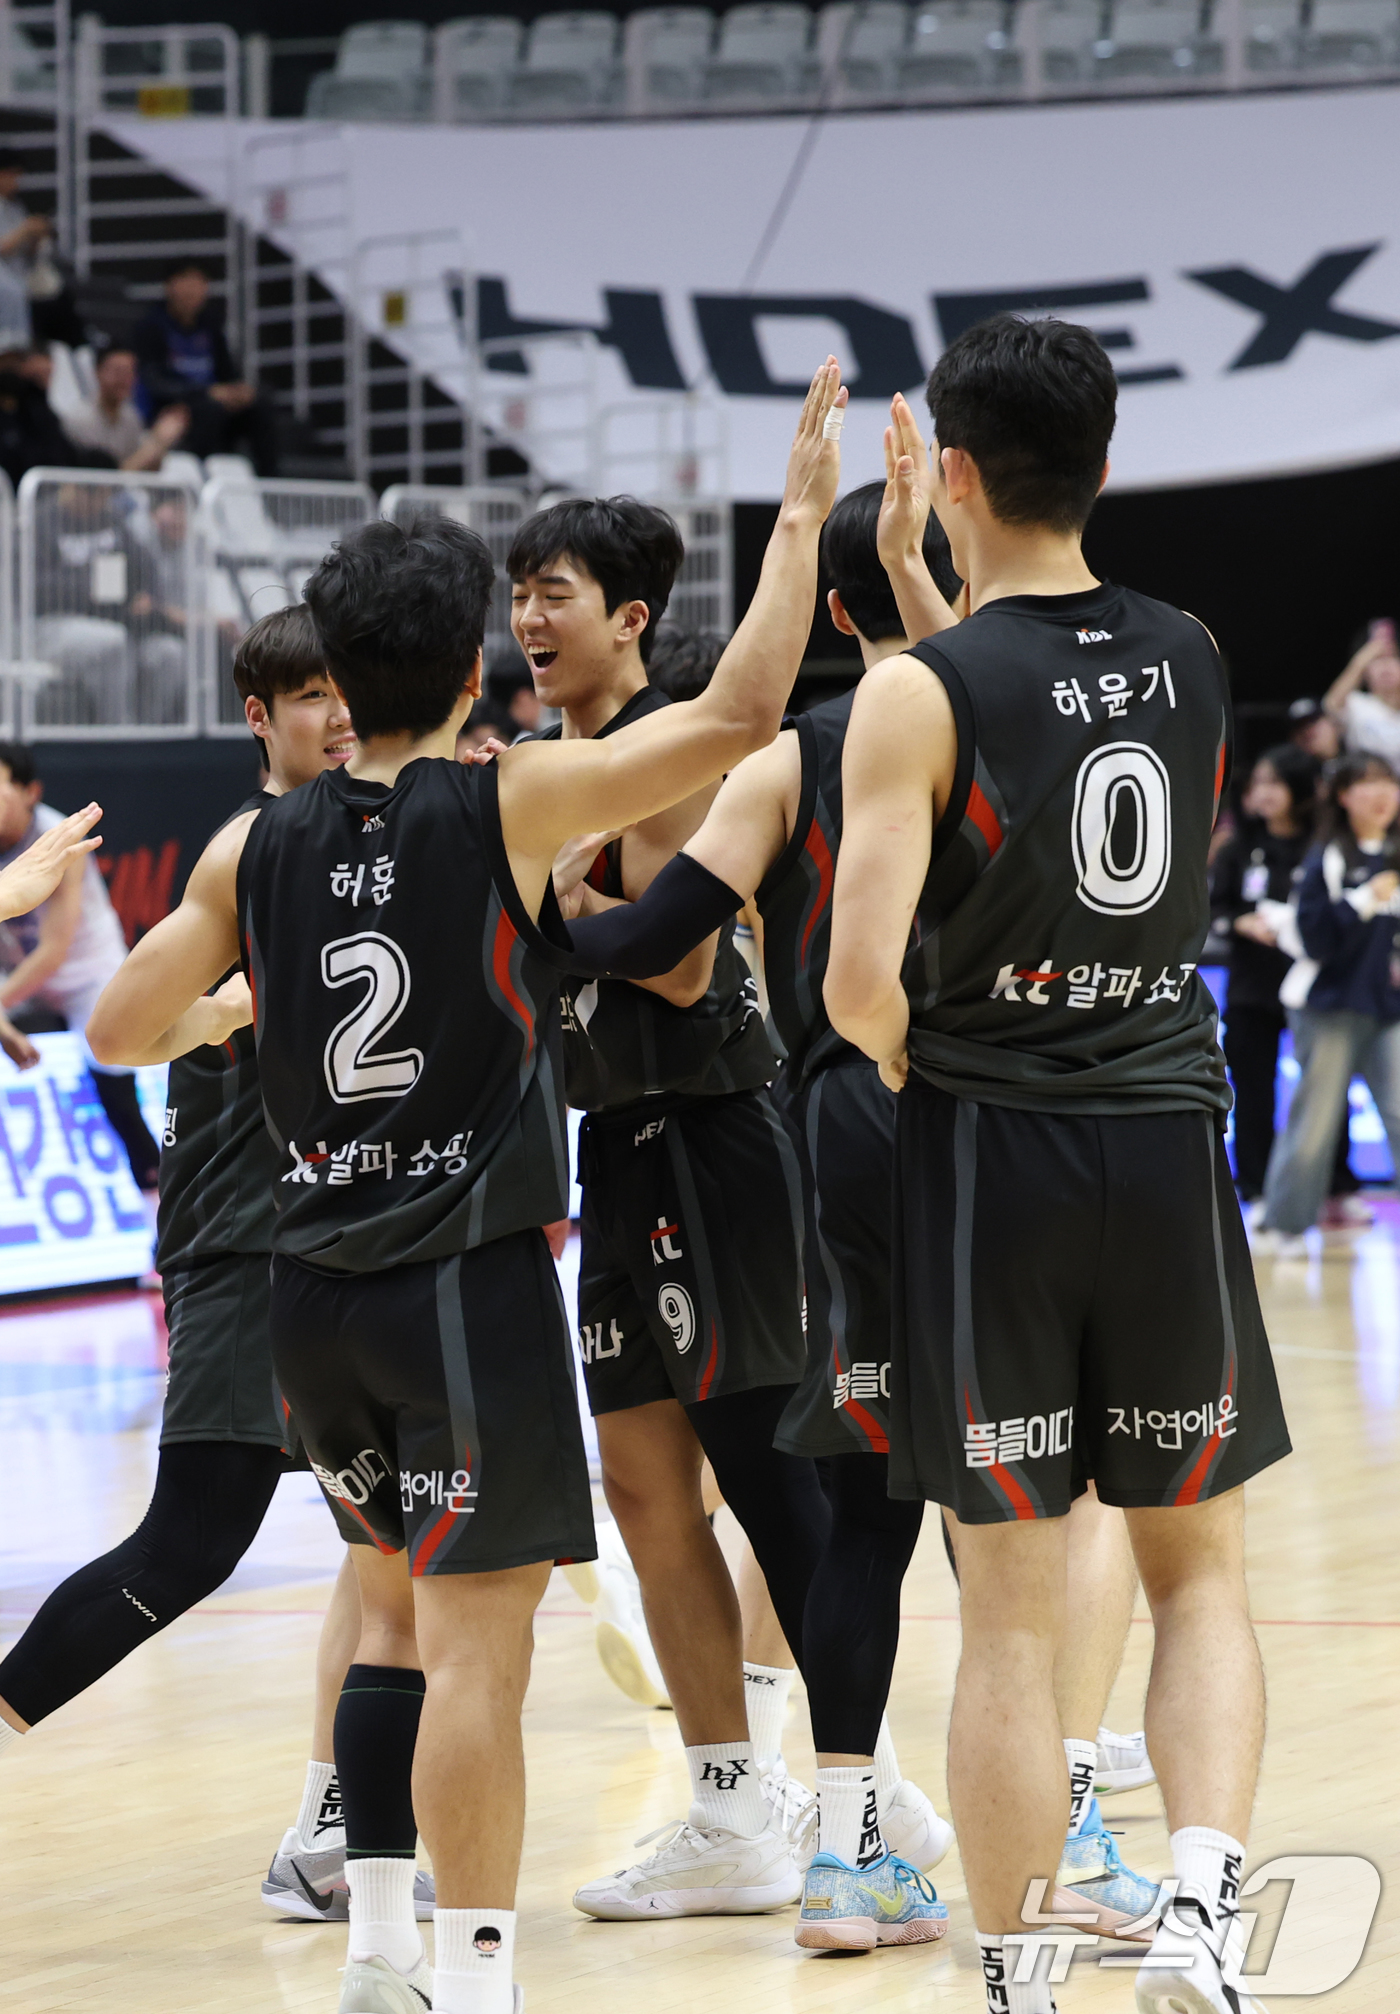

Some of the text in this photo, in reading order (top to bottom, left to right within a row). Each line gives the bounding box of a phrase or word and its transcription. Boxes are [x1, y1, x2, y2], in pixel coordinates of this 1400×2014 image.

[446, 239, 1400, 399] HDEX
[1051, 660, 1176, 723] 하윤기
[1070, 740, 1172, 916] 0
[329, 854, 395, 907] 허훈
[320, 930, 425, 1104] 2
[406, 1130, 474, 1176] 쇼핑
[658, 1282, 696, 1355] 9
[964, 1406, 1074, 1468] 뜸들이다
[1107, 1394, 1239, 1450] 자연에온
